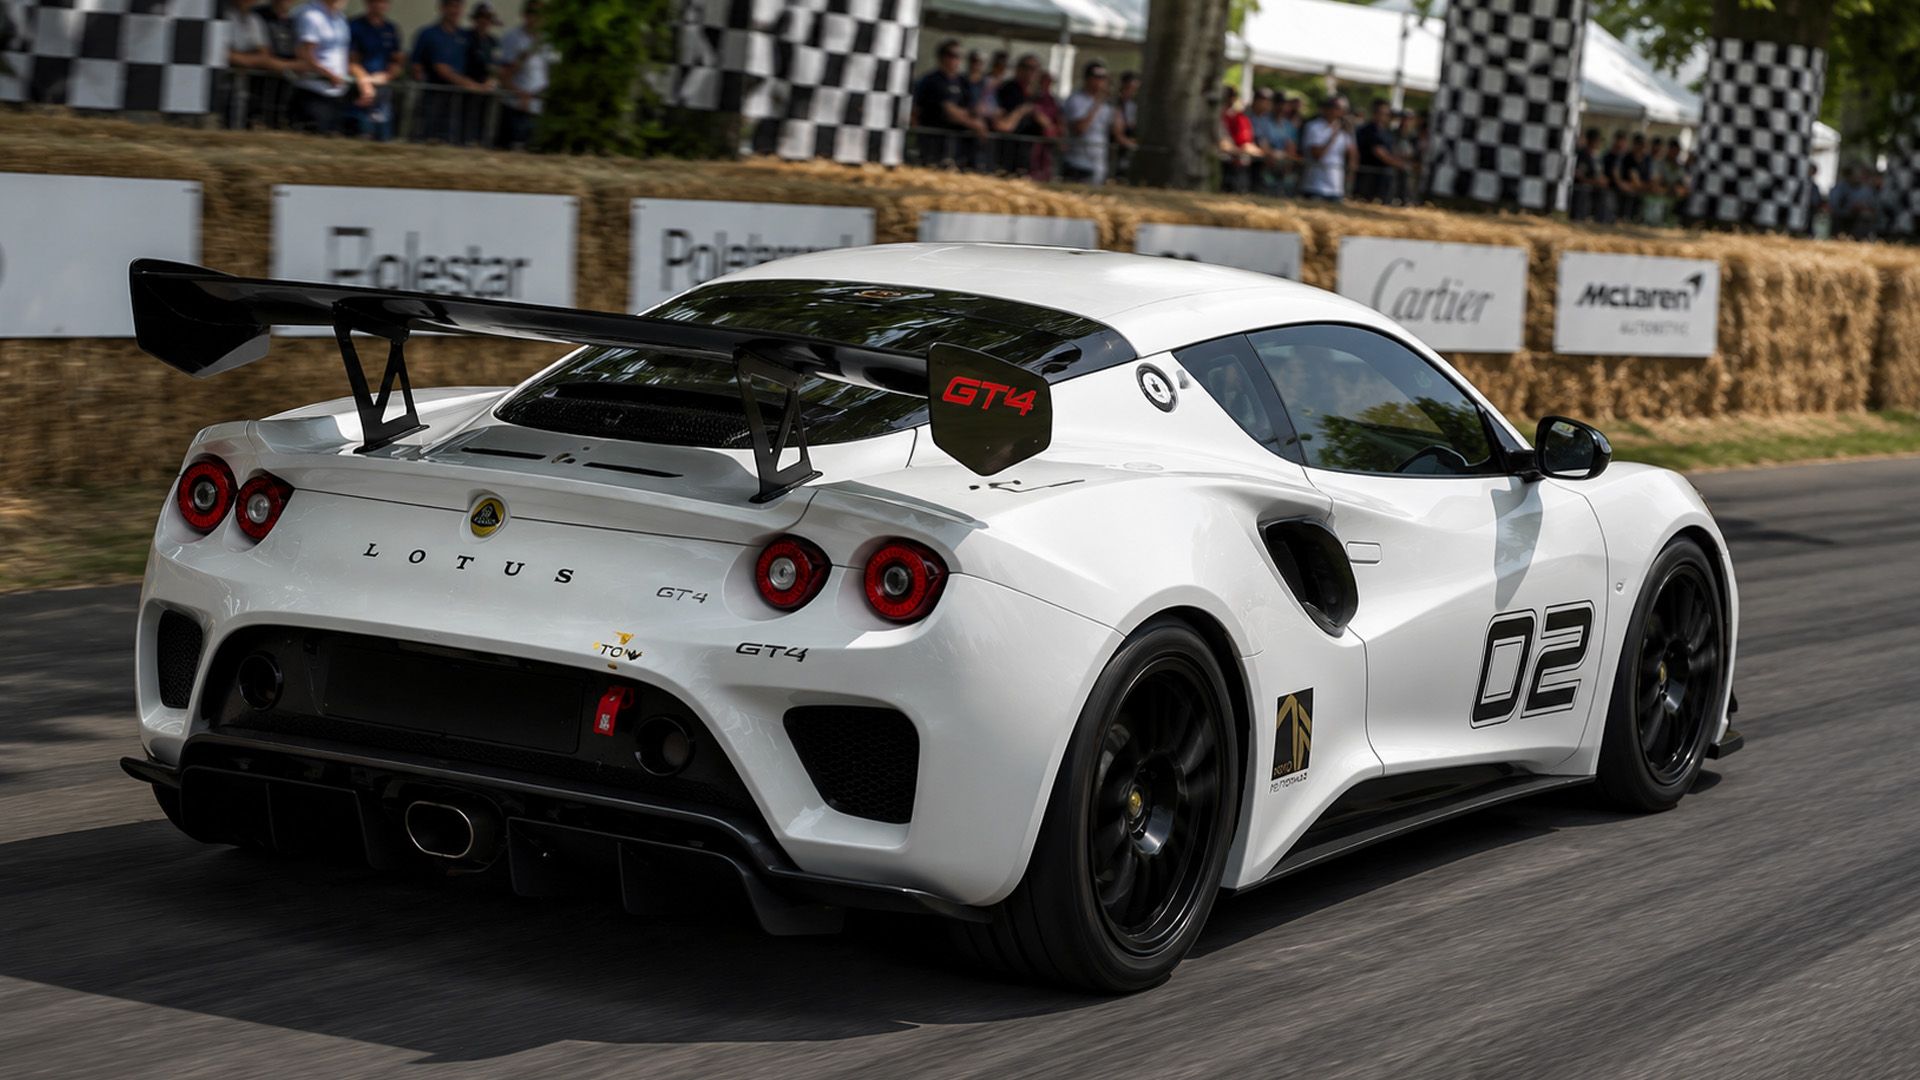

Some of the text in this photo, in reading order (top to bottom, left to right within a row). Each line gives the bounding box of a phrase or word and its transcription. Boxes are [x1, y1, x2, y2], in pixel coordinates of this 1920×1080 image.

[326, 227, 531, 298] Polestar
[1371, 257, 1494, 324] Cartier
[1576, 282, 1691, 312] McLaren
[942, 376, 1037, 416] GT4
[363, 543, 574, 584] LOTUS
[656, 587, 708, 603] GT4
[735, 642, 809, 662] GT4
[1469, 599, 1596, 729] 02
